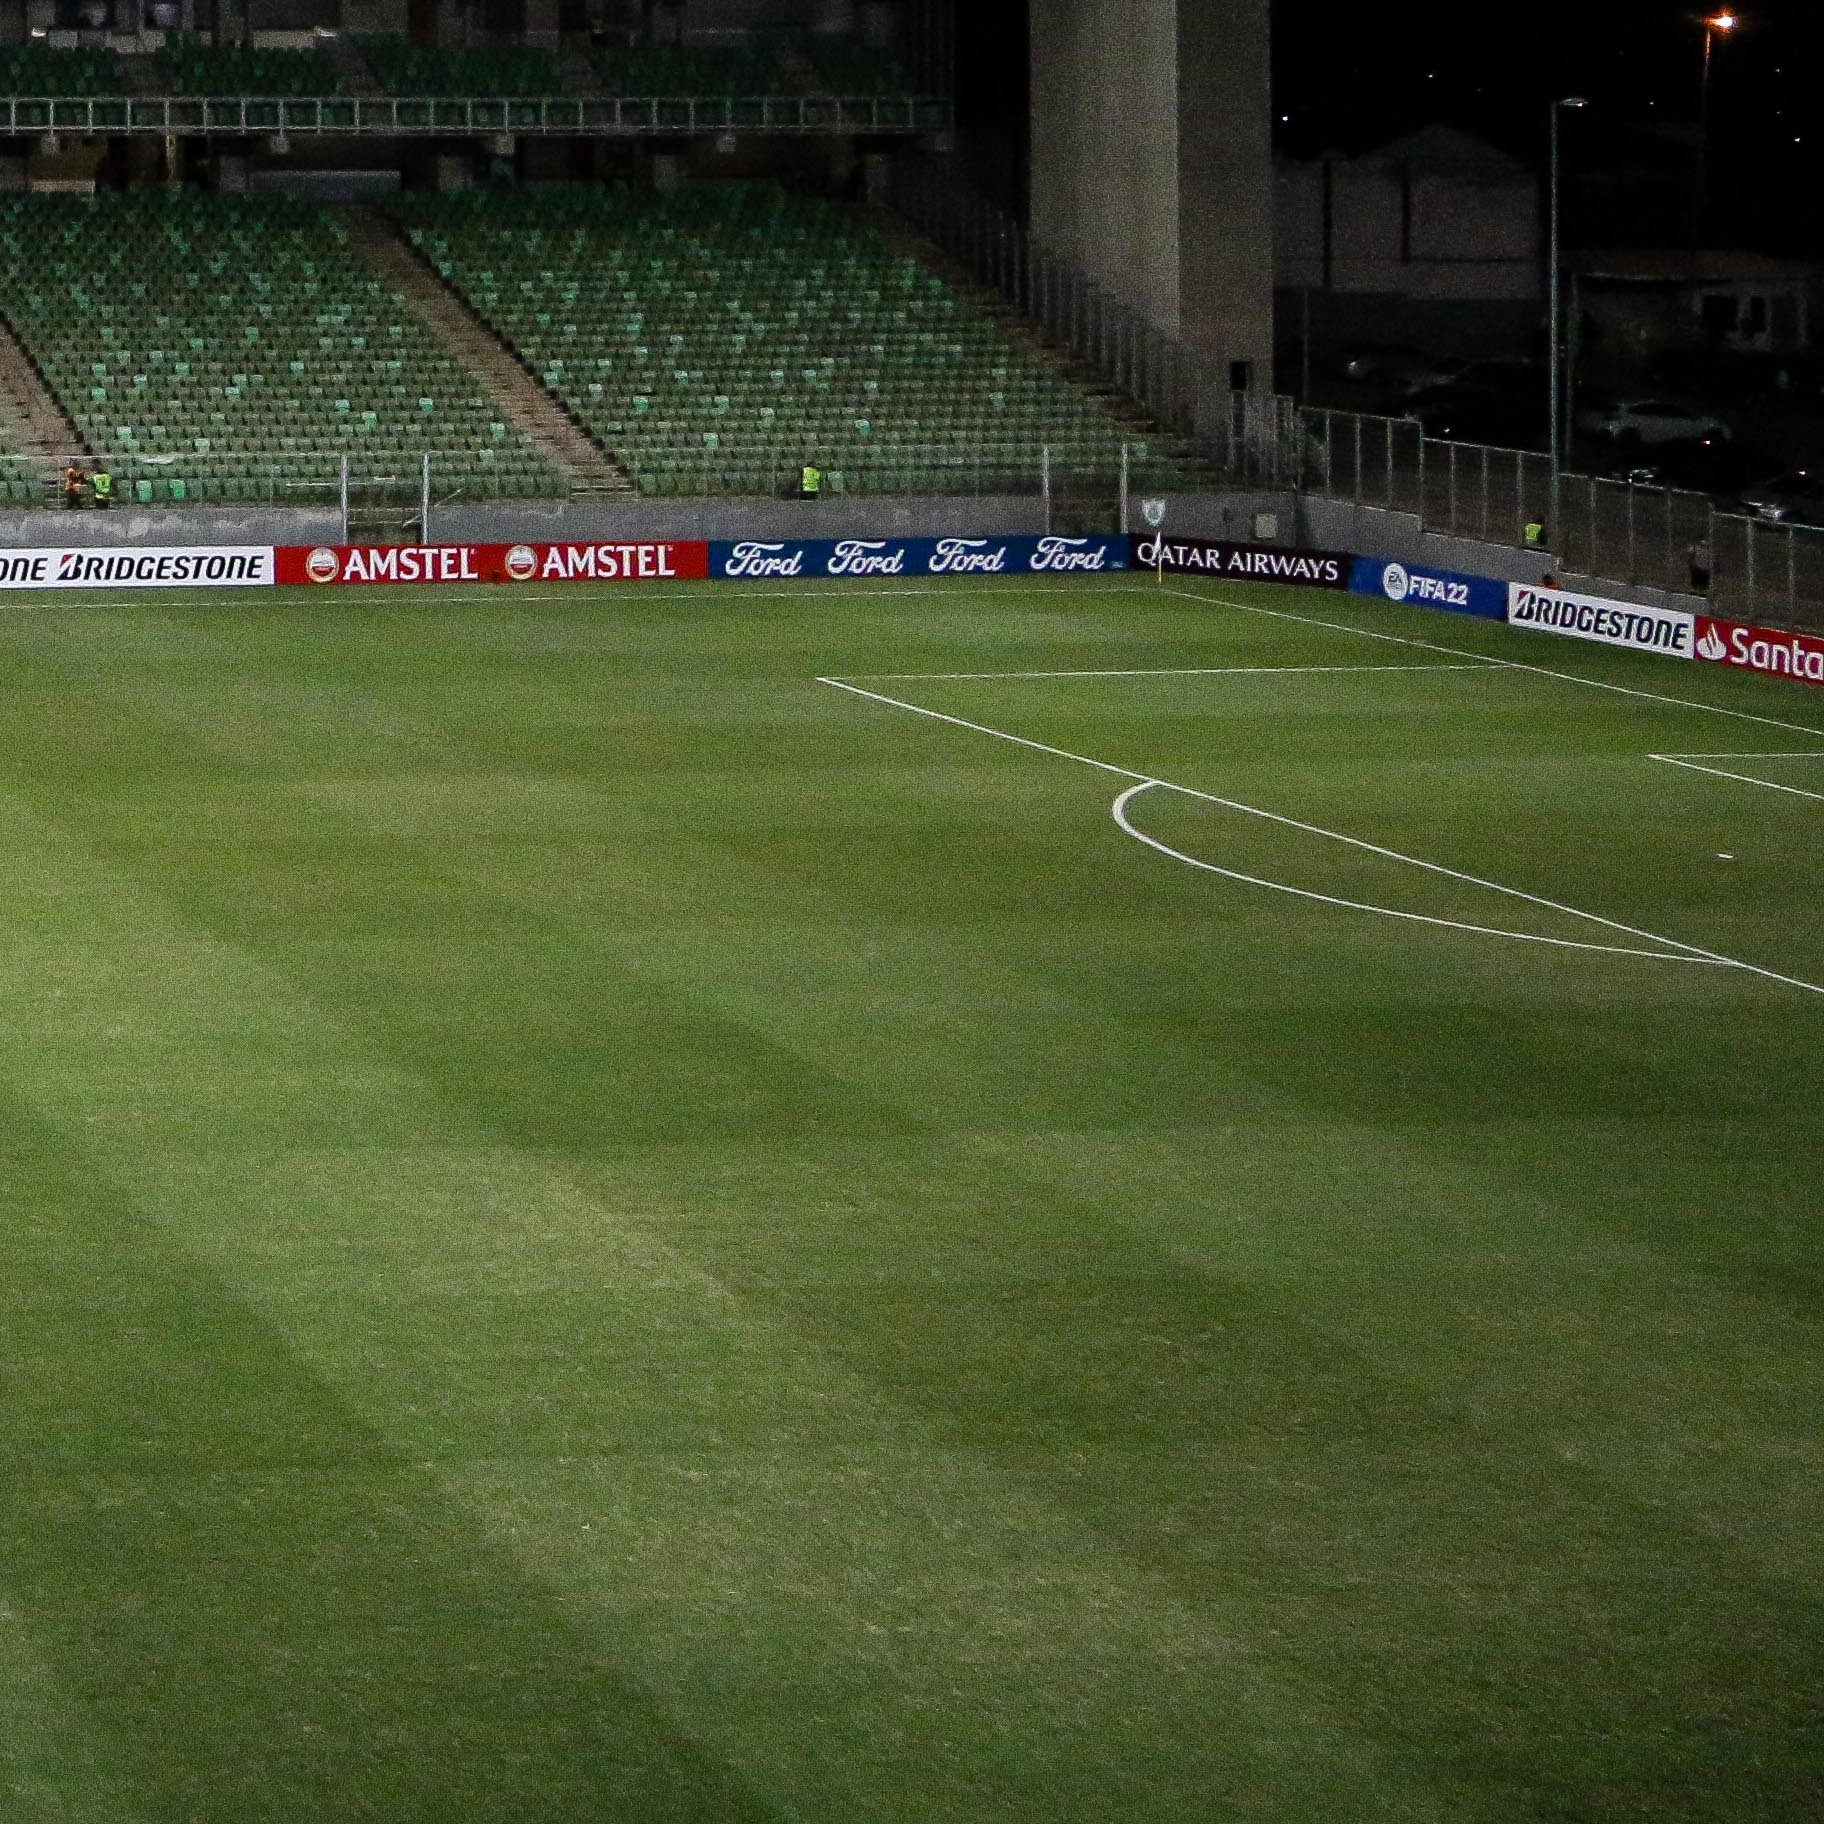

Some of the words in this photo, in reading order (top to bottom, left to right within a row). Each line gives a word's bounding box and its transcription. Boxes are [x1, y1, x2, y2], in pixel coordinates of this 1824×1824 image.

[57, 553, 263, 582] BRIDGESTONE
[343, 547, 477, 580] AMSTEL
[542, 545, 674, 578] AMSTEL
[725, 541, 801, 576] Ford
[827, 540, 904, 575] Ford
[928, 538, 1005, 573] Ford
[1030, 536, 1107, 571] Ford
[1137, 542, 1221, 569] QATAR
[1228, 551, 1339, 582] AIRWAYS
[1409, 575, 1446, 600] FIFA
[1446, 582, 1468, 605] 22
[1515, 589, 1689, 651] BRIDGESTONE
